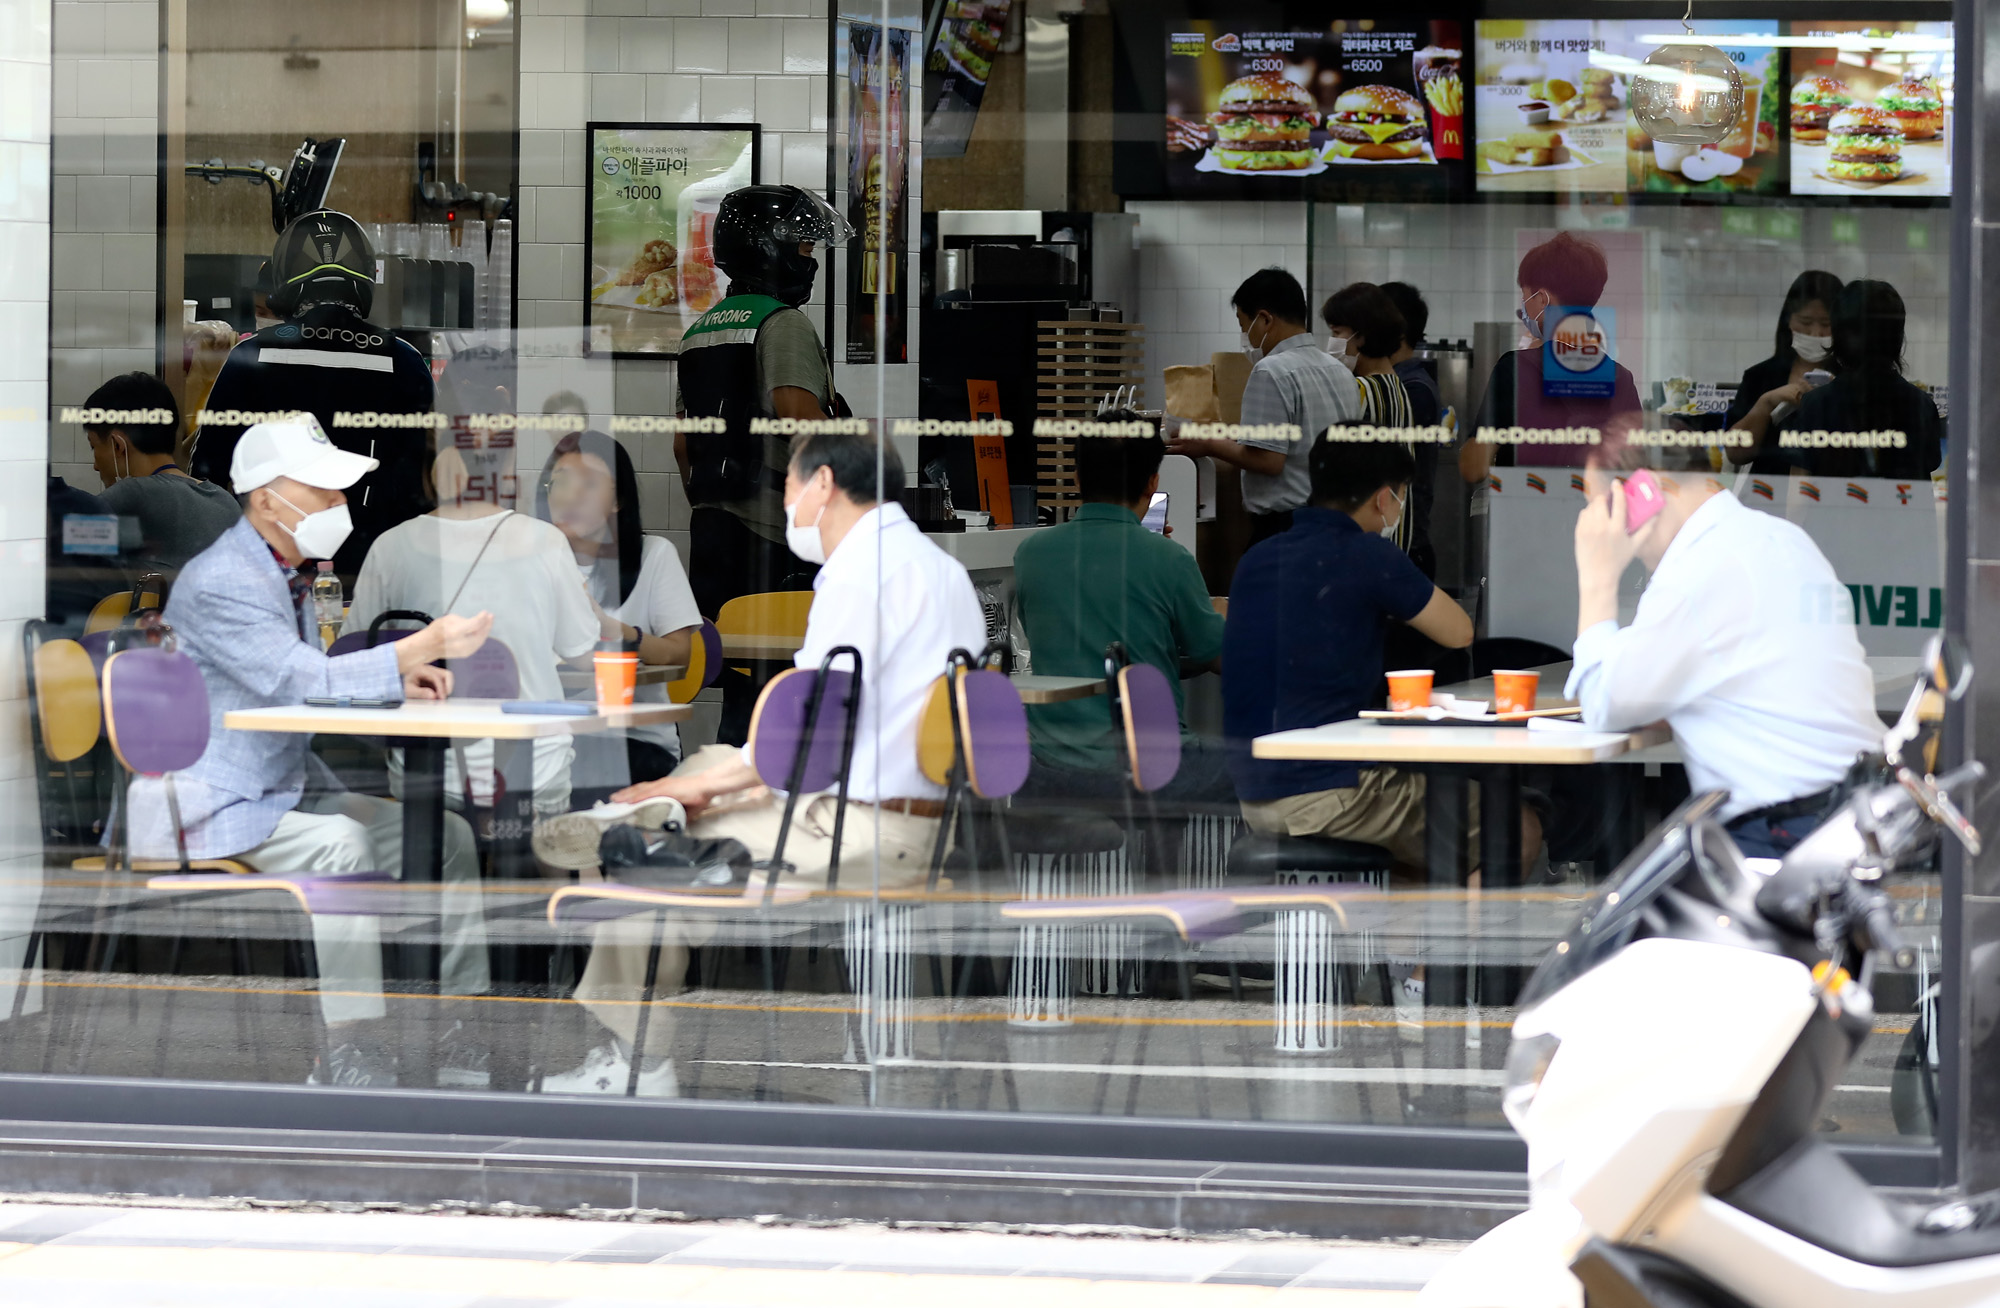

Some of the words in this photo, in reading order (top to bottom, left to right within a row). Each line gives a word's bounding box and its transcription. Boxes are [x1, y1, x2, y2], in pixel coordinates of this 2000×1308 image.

[1265, 39, 1294, 52] 베이컨
[1394, 39, 1415, 52] 치즈
[1496, 40, 1527, 52] 버거와
[1530, 40, 1552, 53] 함께
[1554, 40, 1565, 52] 더
[1567, 40, 1605, 53] 맛있게!
[1252, 59, 1283, 71] 6300
[1351, 59, 1383, 72] 6500
[1499, 87, 1522, 96] 3000
[1580, 139, 1604, 148] 2000
[622, 156, 688, 176] 애플파이
[616, 189, 623, 198] 각
[624, 185, 661, 200] 1000
[704, 309, 752, 327] VROONG
[301, 323, 383, 349] barogo
[1695, 400, 1728, 411] 2500
[60, 408, 173, 424] McDonald's
[333, 411, 449, 428] McDonald's
[468, 413, 585, 431] McDonald's
[610, 415, 726, 433] McDonald's
[750, 417, 870, 435] McDonald's
[893, 418, 1013, 436] McDonald's
[1033, 419, 1155, 438] McDonald's
[1179, 422, 1302, 440] McDonald's
[1327, 425, 1451, 442] McDonald's
[1476, 427, 1602, 445] McDonald's
[1626, 428, 1753, 447] McDonald's
[1780, 430, 1906, 448] McDonald's
